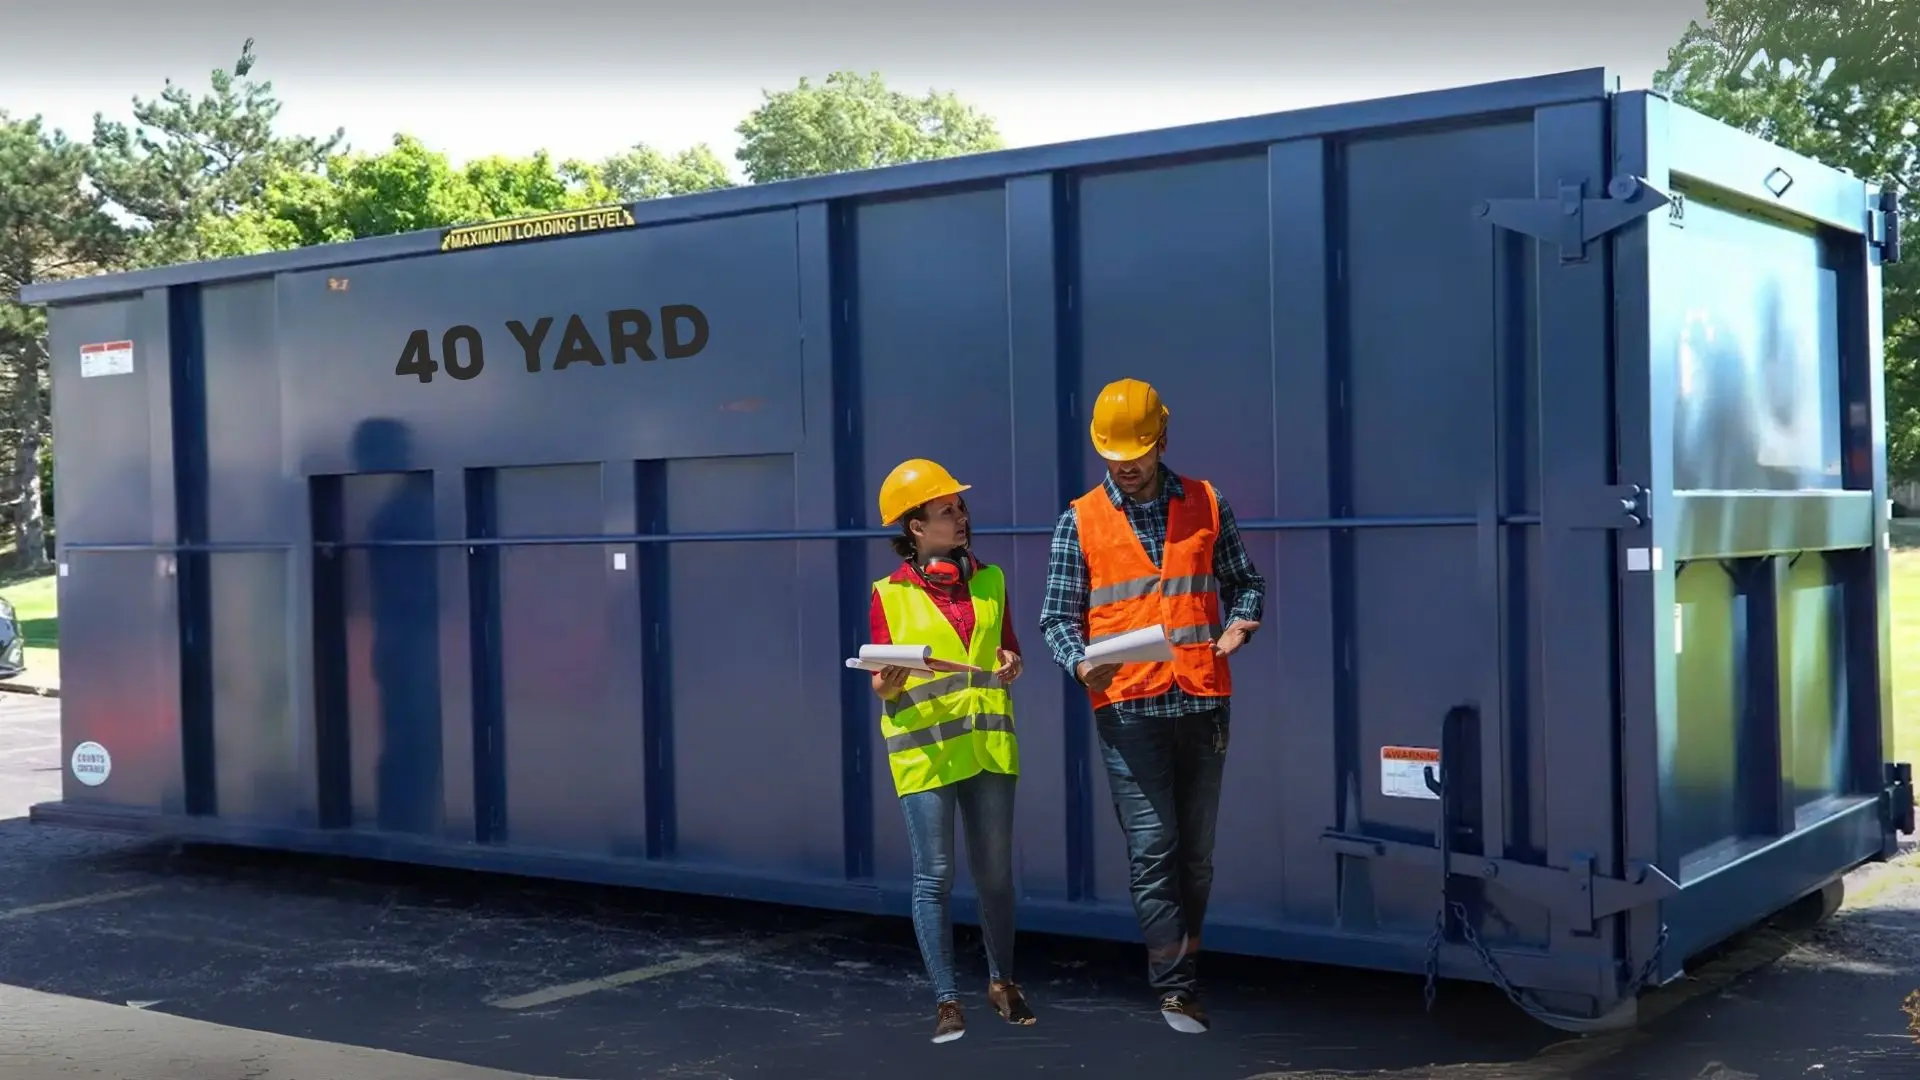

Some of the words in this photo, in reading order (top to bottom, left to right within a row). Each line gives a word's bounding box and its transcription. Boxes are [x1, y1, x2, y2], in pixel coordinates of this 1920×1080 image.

[450, 228, 512, 248] MAXIMUM
[516, 218, 577, 239] LOADING
[580, 212, 625, 230] LEVEL
[396, 325, 484, 383] 40
[505, 304, 709, 372] YARD
